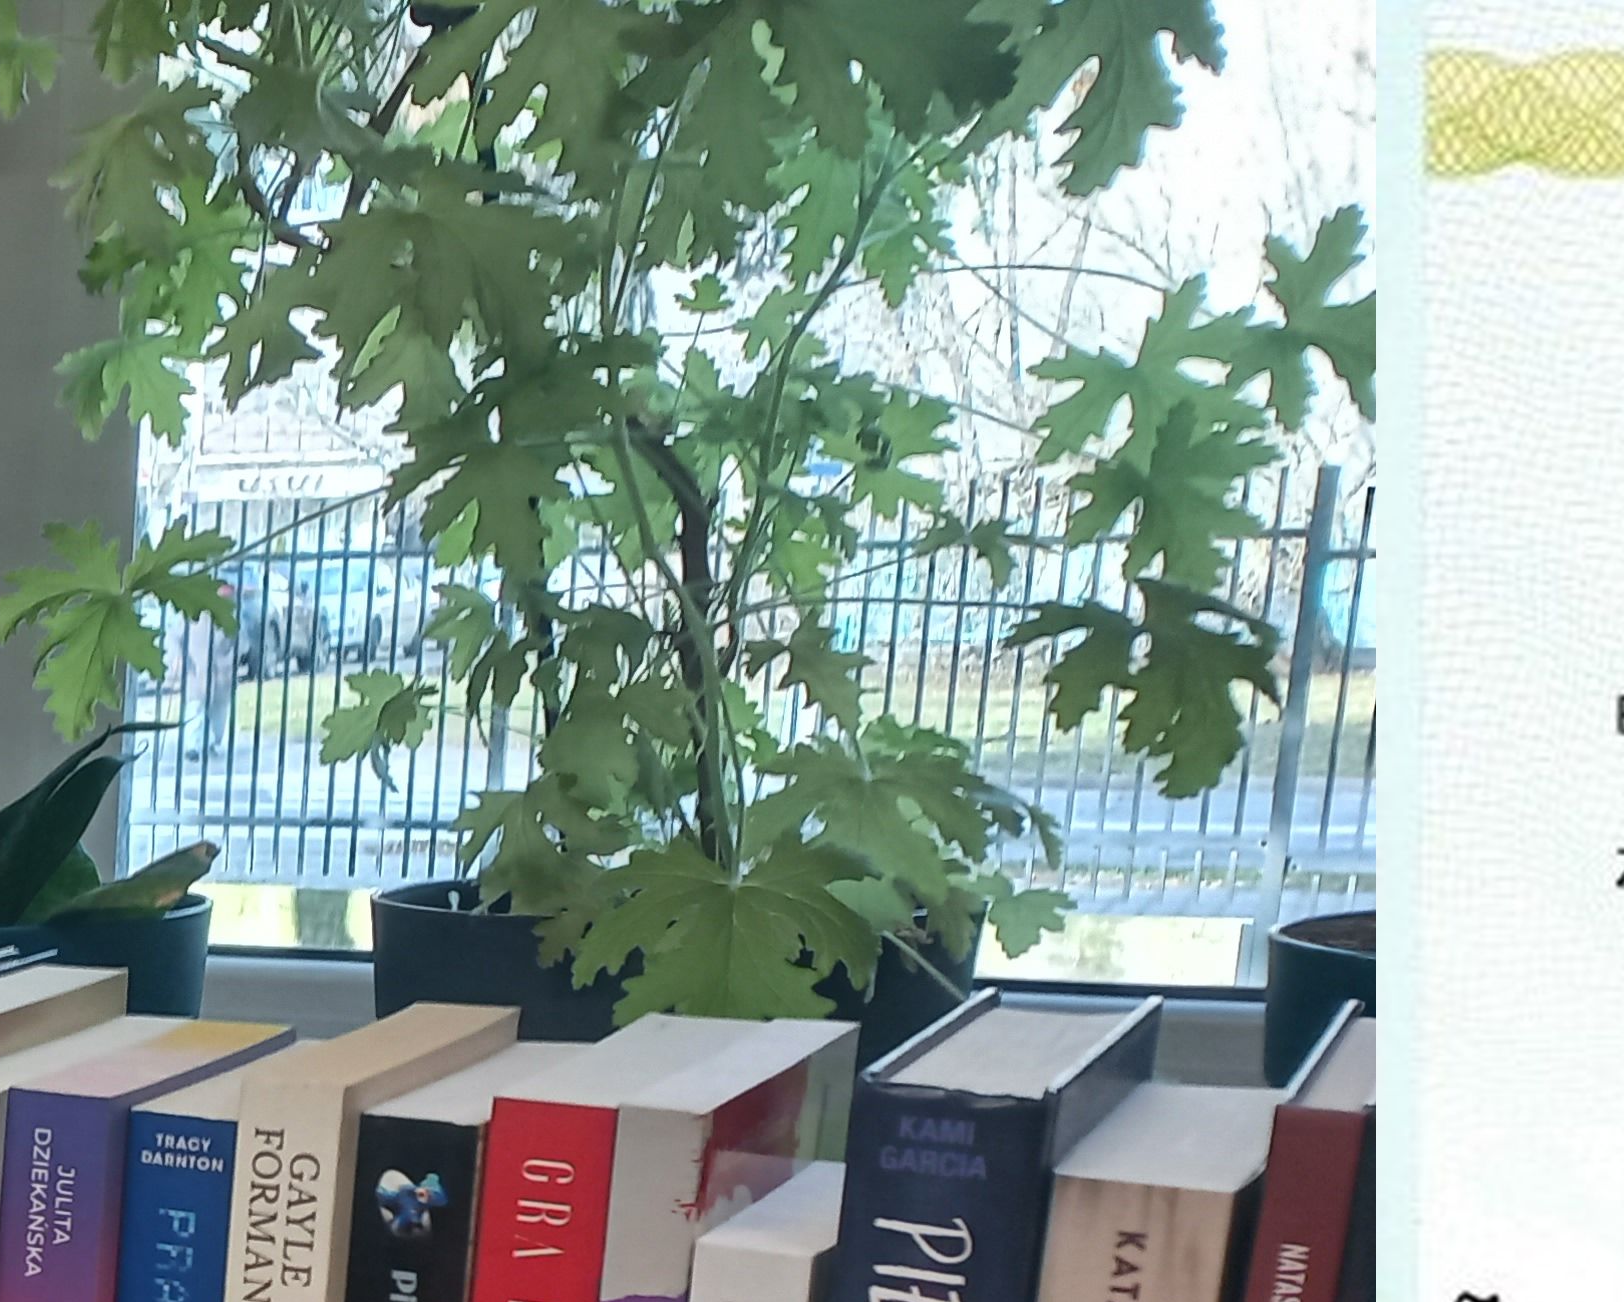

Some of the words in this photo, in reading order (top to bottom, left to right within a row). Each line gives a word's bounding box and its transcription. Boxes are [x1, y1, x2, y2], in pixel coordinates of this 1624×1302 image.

[140, 1149, 225, 1174] DARNTON
[154, 1132, 213, 1153] TRACY
[23, 1126, 53, 1279] DZIEKAŃSKA
[52, 1164, 76, 1247] JULITA
[279, 1151, 322, 1289] GAYLE
